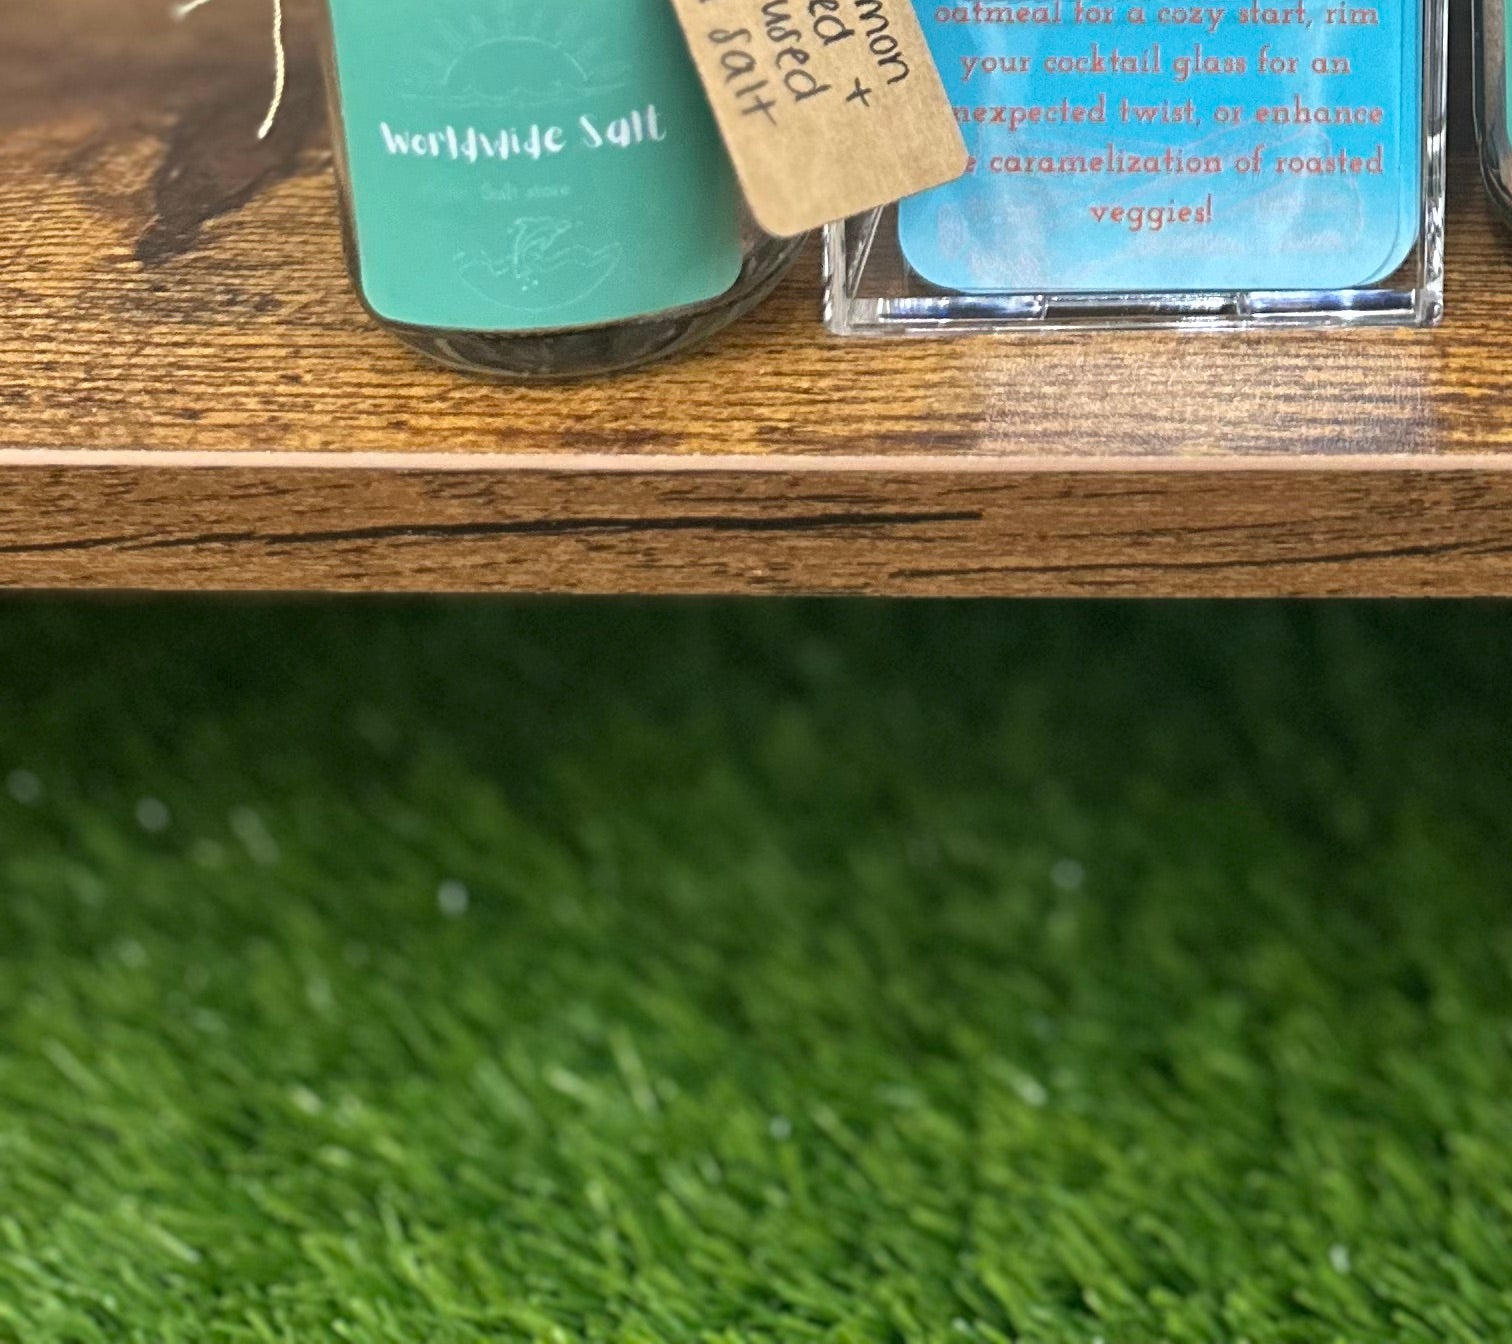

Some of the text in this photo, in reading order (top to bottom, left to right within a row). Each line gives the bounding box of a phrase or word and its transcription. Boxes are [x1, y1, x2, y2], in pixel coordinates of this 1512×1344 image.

[1125, 5, 1147, 26] a
[1156, 5, 1226, 35] cozy
[1324, 1, 1380, 27] rim
[959, 43, 1353, 84] your cocktail glass for an
[846, 77, 871, 108] +
[951, 93, 1385, 132] nexpected twist, or enhance
[379, 104, 667, 164] Worldwide Salt
[988, 141, 1225, 176] caramelization
[1232, 143, 1266, 175] of
[1275, 143, 1385, 176] roasted
[1088, 195, 1213, 233] veggies!
